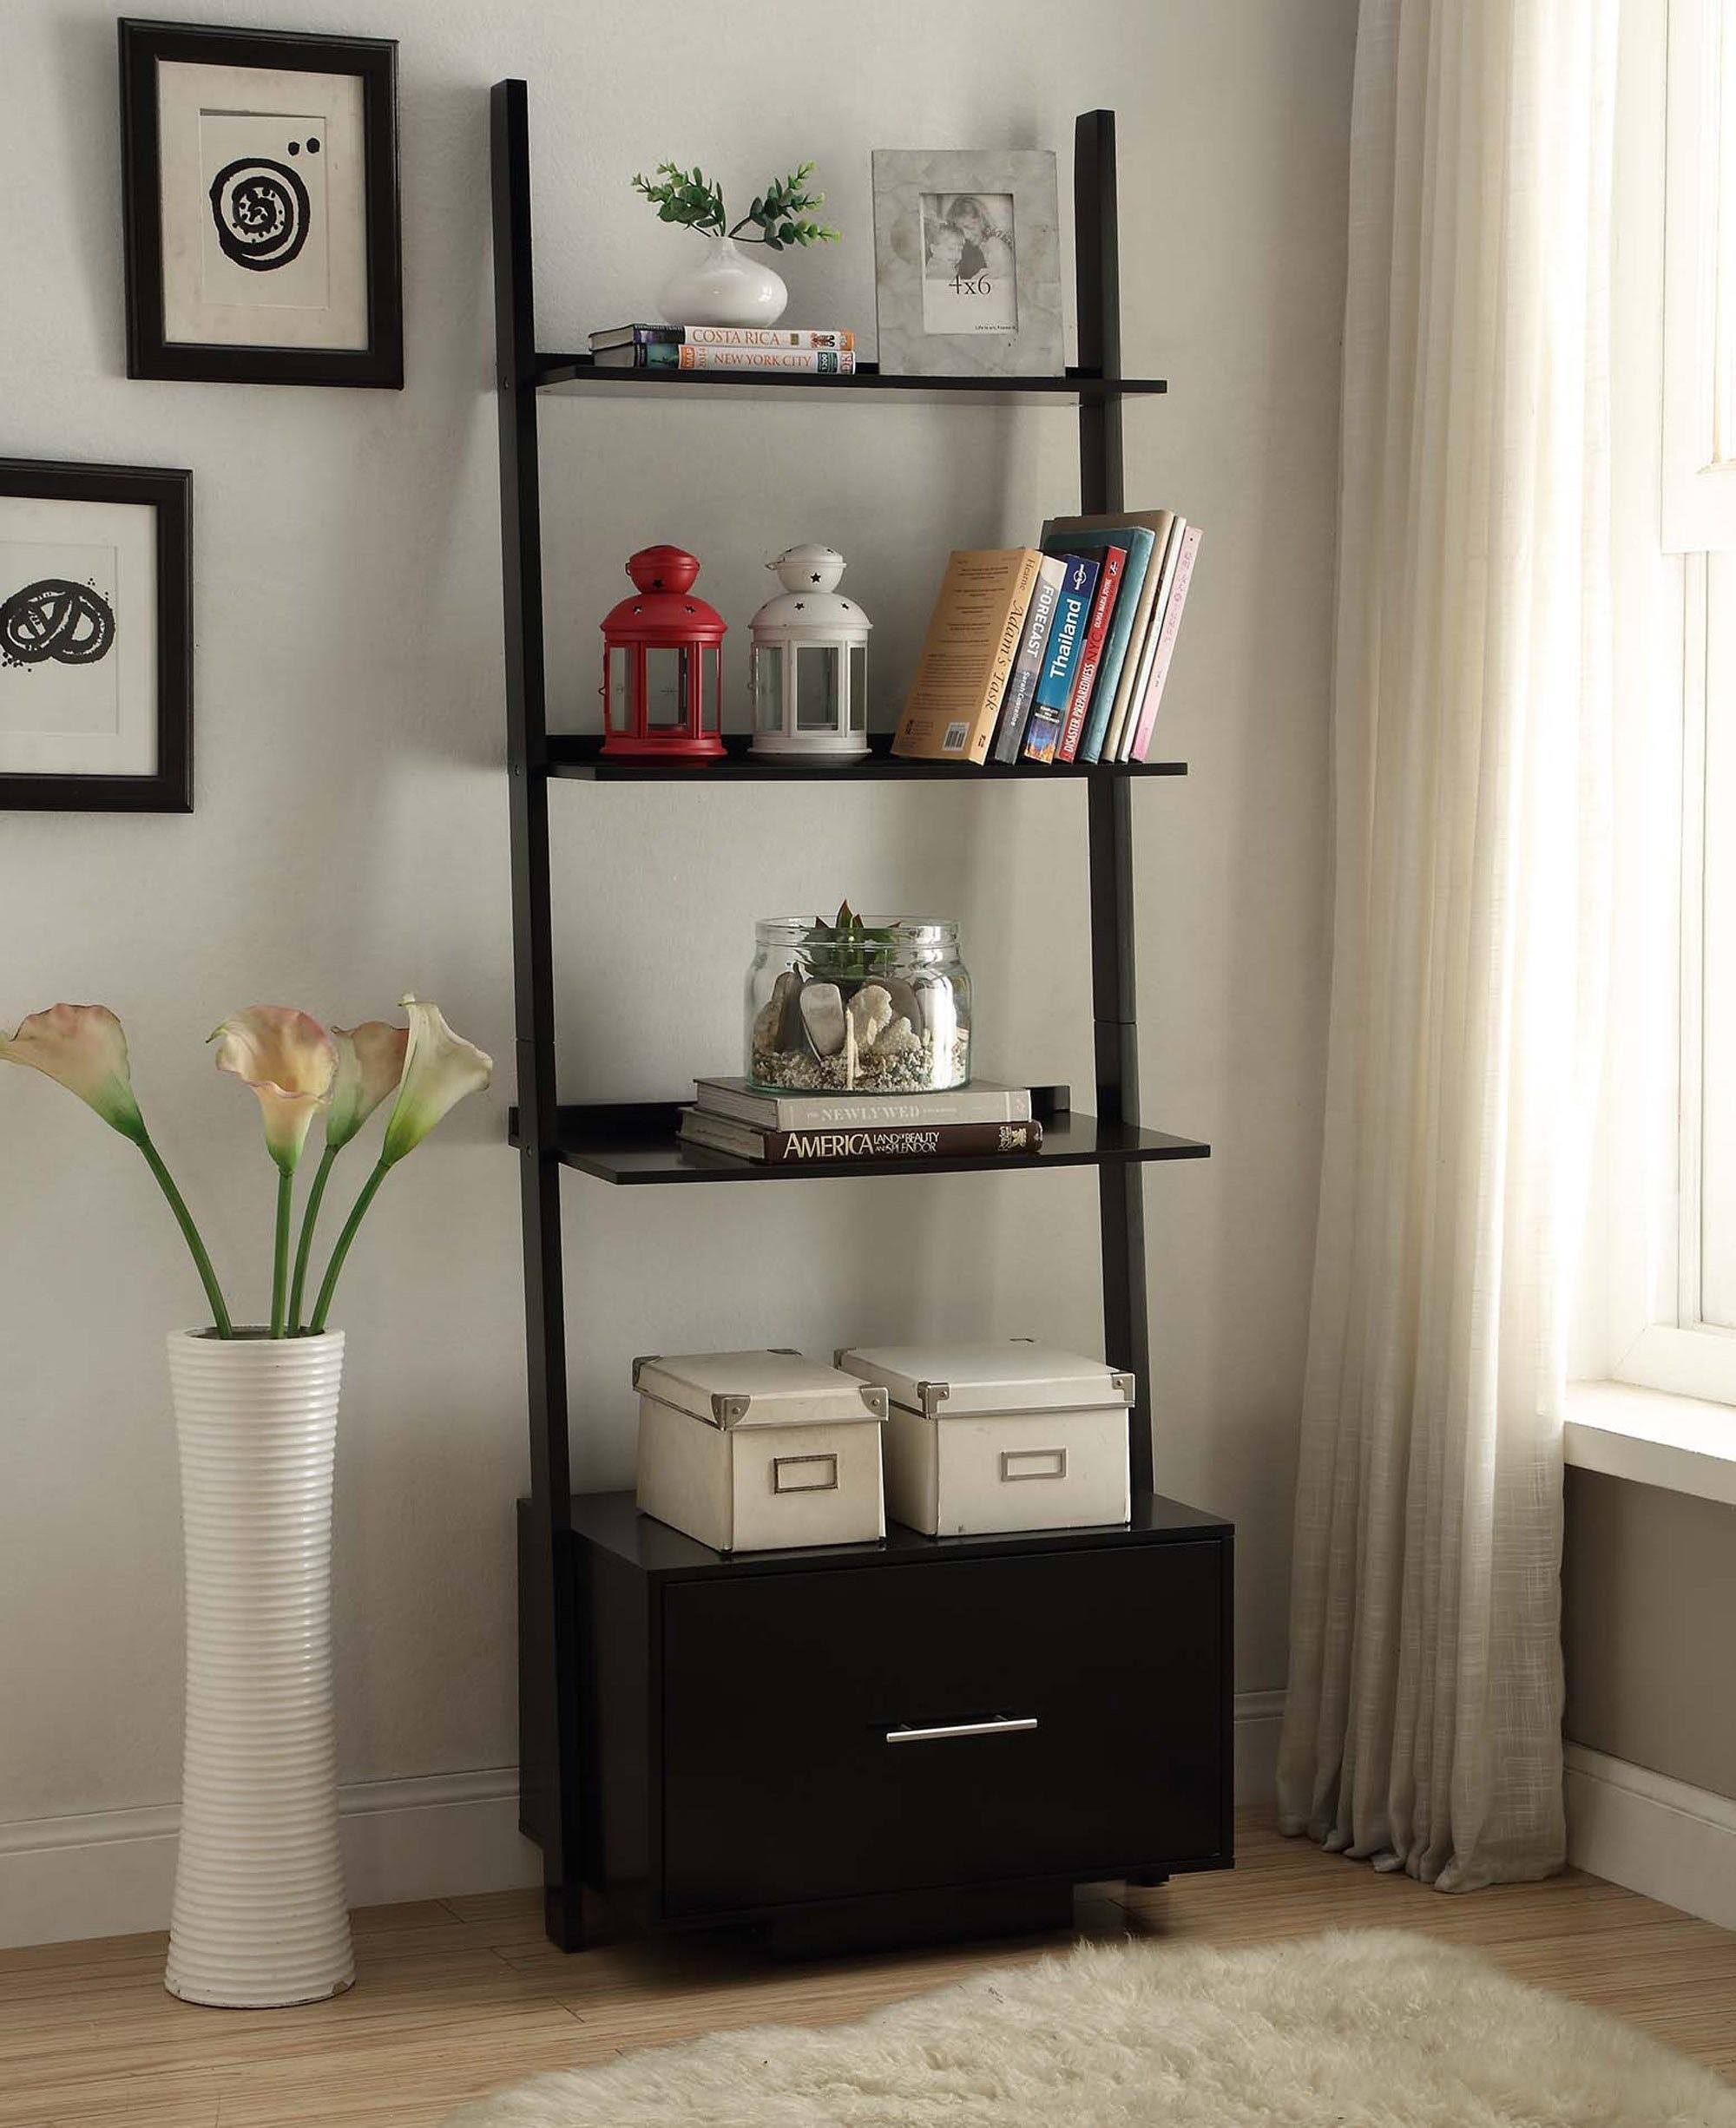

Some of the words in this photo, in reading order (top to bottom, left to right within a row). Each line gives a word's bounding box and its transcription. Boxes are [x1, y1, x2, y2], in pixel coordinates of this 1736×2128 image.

[693, 328, 740, 345] COSTA
[745, 329, 780, 345] RICA
[713, 353, 742, 365] NEW
[744, 354, 780, 366] YORK
[782, 355, 812, 367] CITY
[998, 600, 1024, 667] Adam's
[1027, 585, 1055, 658] FORECAST
[1049, 598, 1082, 679] Thailand
[985, 672, 1004, 711] Task
[1063, 718, 1080, 752] DISASTER
[1074, 663, 1095, 720] PREPAREDNESS
[1087, 632, 1103, 664] NYC
[821, 1104, 920, 1121] NEWLYWED
[783, 1132, 873, 1159] AMERICA
[873, 1133, 898, 1145] LAND
[904, 1132, 940, 1143] BEAUTY
[884, 1142, 937, 1154] SPLENDOR
